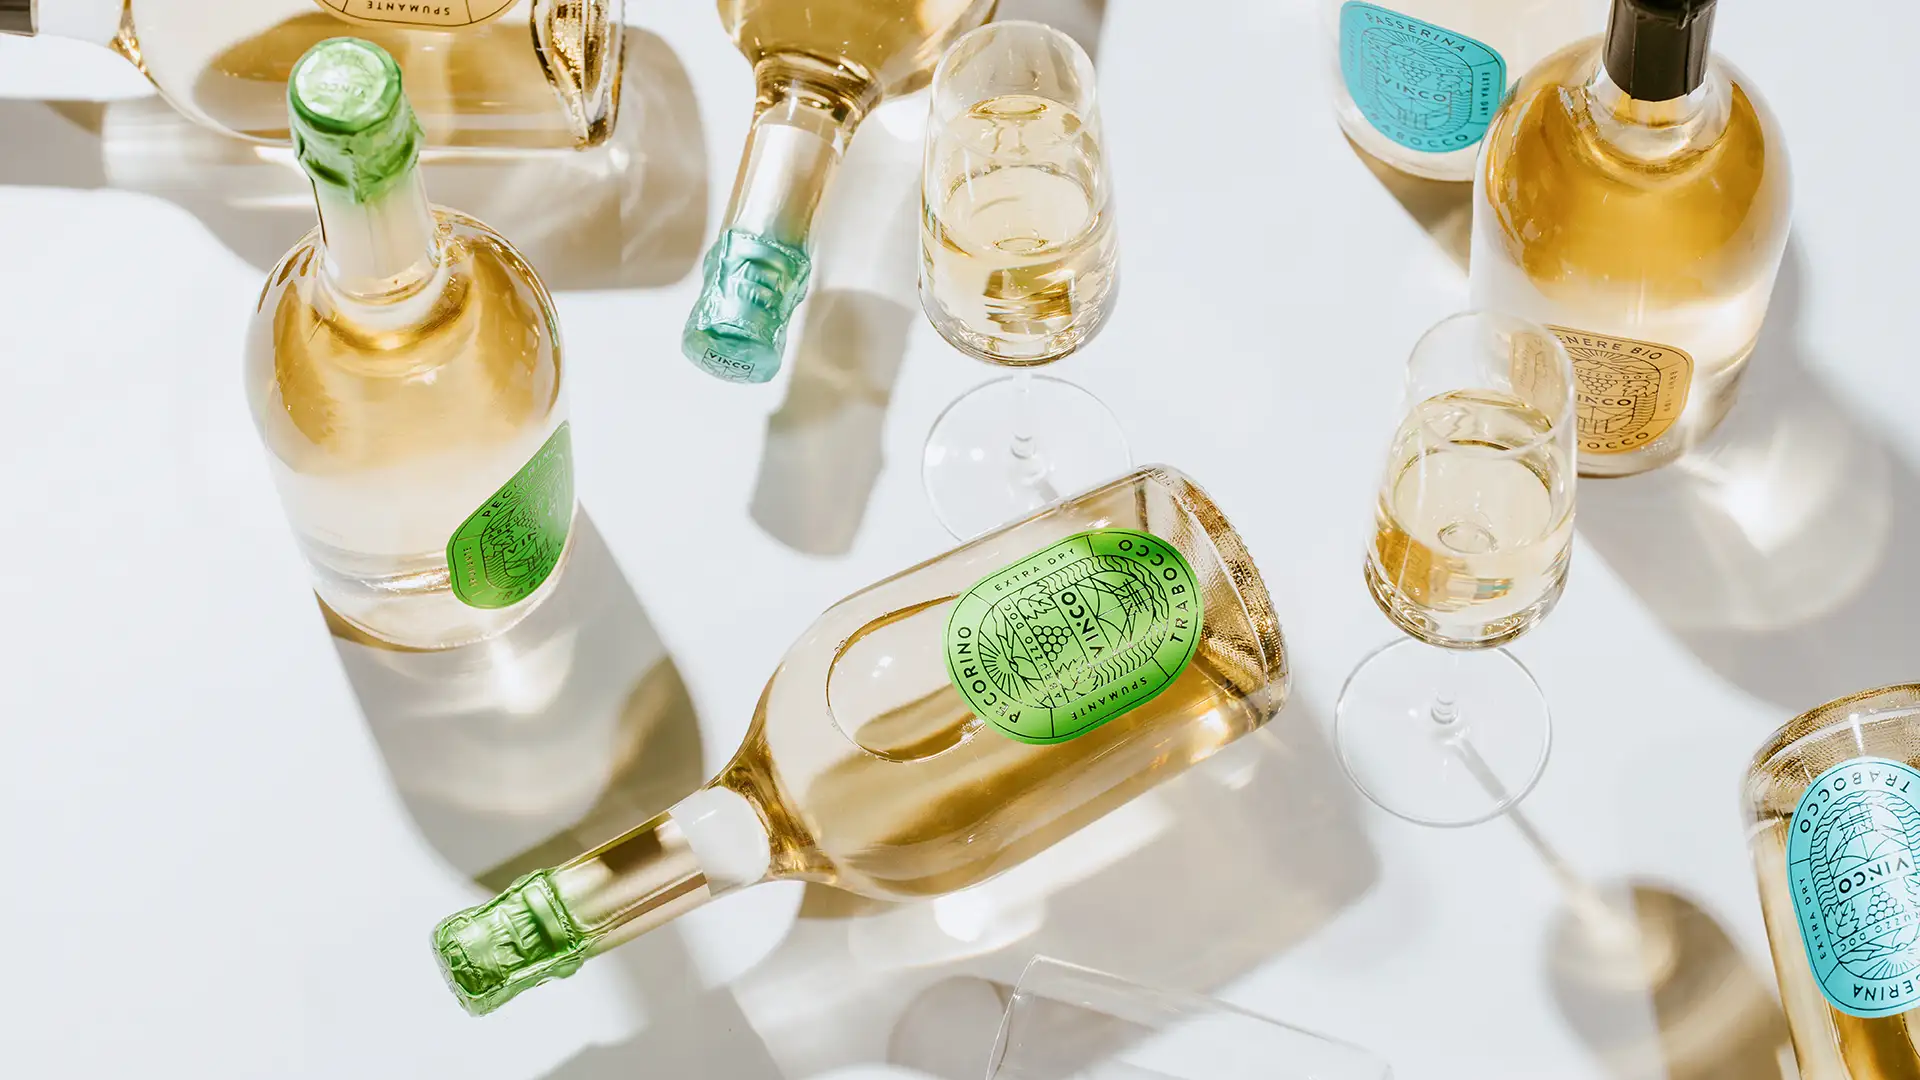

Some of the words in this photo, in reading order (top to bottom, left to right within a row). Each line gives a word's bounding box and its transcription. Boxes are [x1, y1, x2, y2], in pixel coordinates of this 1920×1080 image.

[367, 0, 450, 16] SPUMANTE
[1364, 12, 1466, 53] PASSERINA
[1380, 74, 1447, 102] VINCO
[1361, 104, 1468, 148] TRABOCCO
[709, 351, 751, 371] VINCO
[1630, 346, 1663, 360] BIO
[1577, 394, 1632, 406] INCO
[1577, 432, 1649, 449] OCCO
[994, 565, 1041, 592] EXTRA
[1047, 547, 1076, 566] DRY
[1118, 539, 1190, 645] TRABOCCO
[1003, 603, 1025, 630] DOC
[1060, 591, 1106, 660] VINCO
[957, 626, 1022, 724] PECORINO
[1024, 636, 1063, 698] ABRUZZO
[1071, 676, 1148, 721] SPUMANTE
[1799, 769, 1912, 834] TRABOCCO
[1798, 877, 1812, 905] DRY
[1838, 856, 1909, 894] VINCO
[1810, 912, 1826, 960] EXTRA
[1840, 931, 1867, 952] DOC
[1853, 974, 1920, 1001] ERINA
